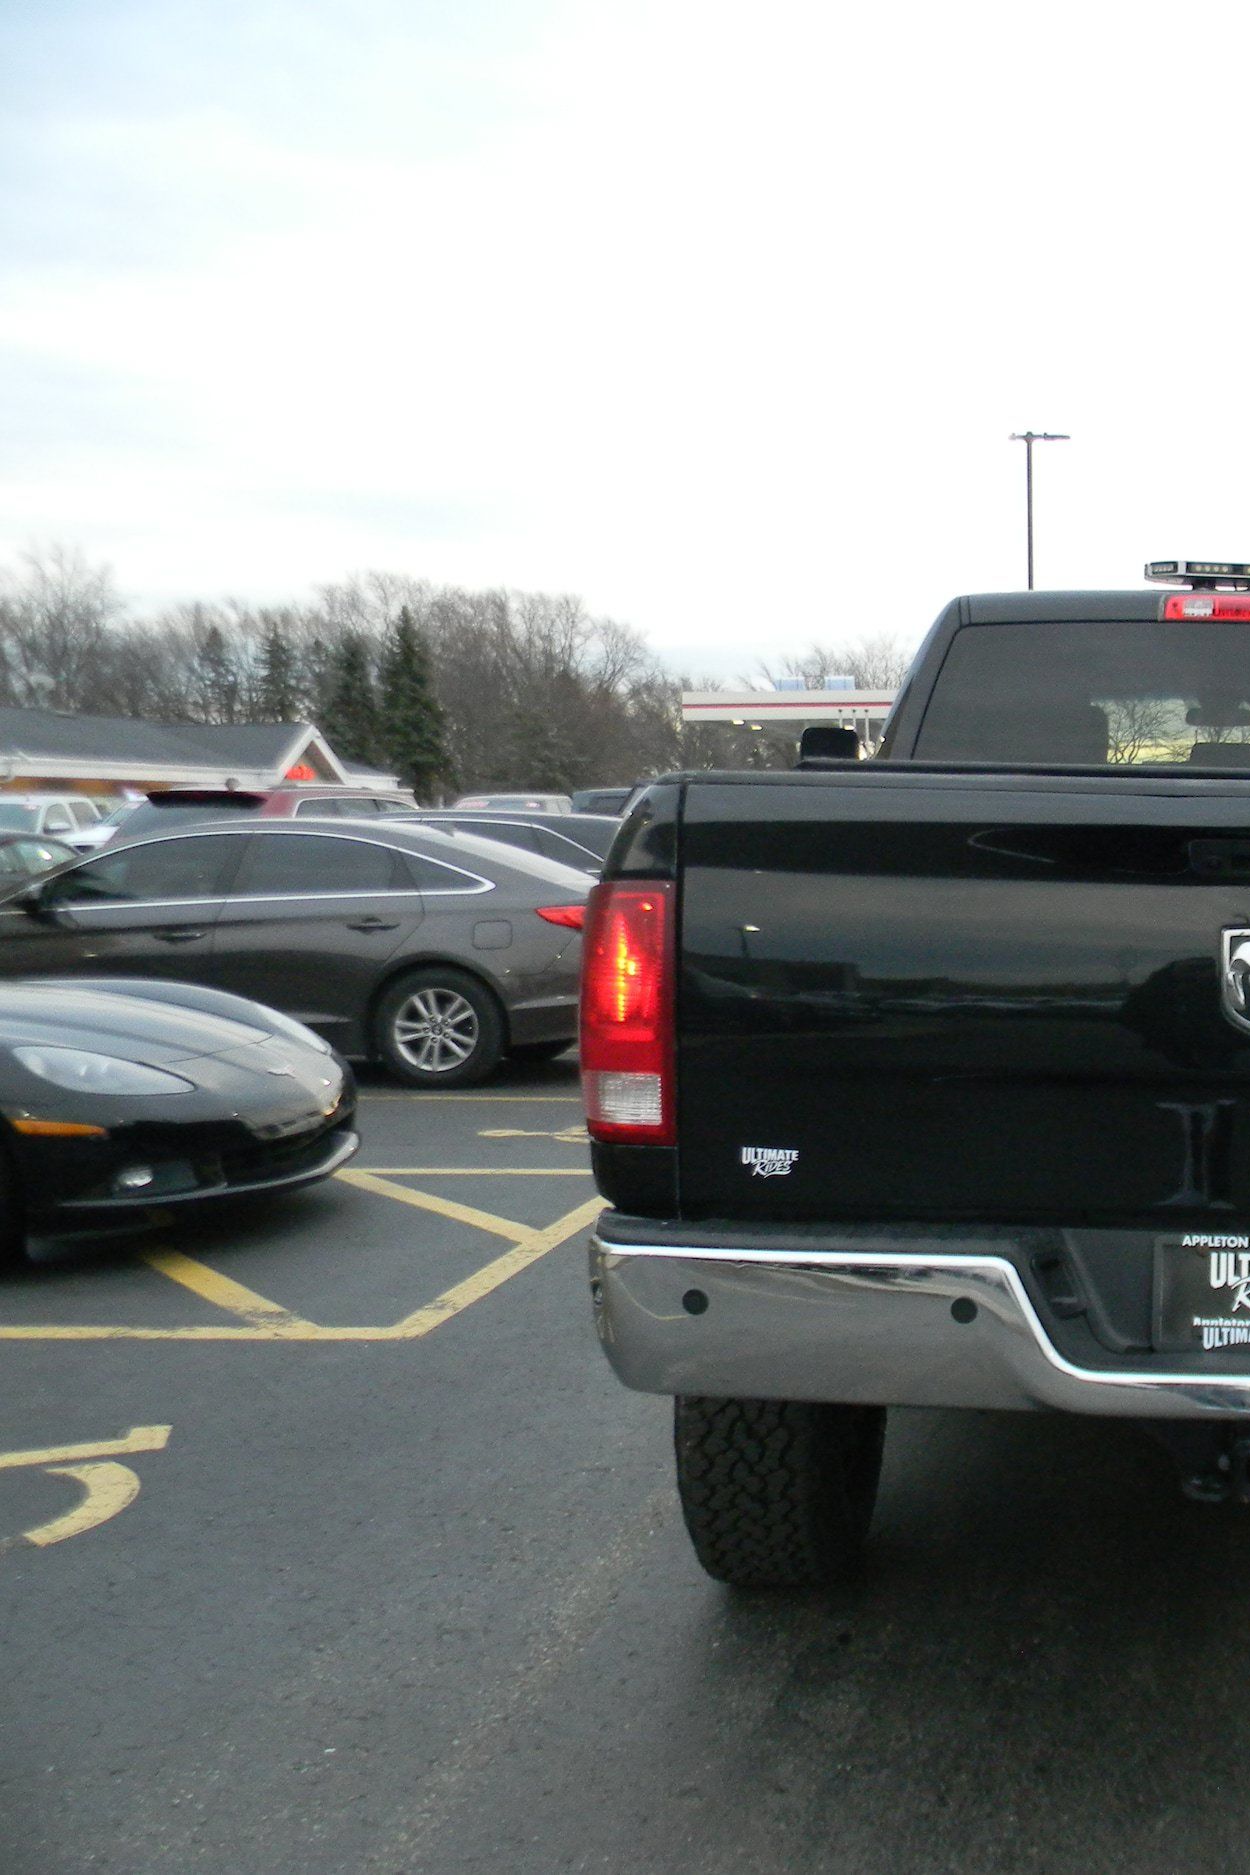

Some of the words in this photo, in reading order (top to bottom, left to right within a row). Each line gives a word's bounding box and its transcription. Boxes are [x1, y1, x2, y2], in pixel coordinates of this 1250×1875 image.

[741, 1147, 800, 1165] ULTIMATE
[752, 1160, 794, 1178] RIDES
[1182, 1235, 1249, 1248] APPLETON
